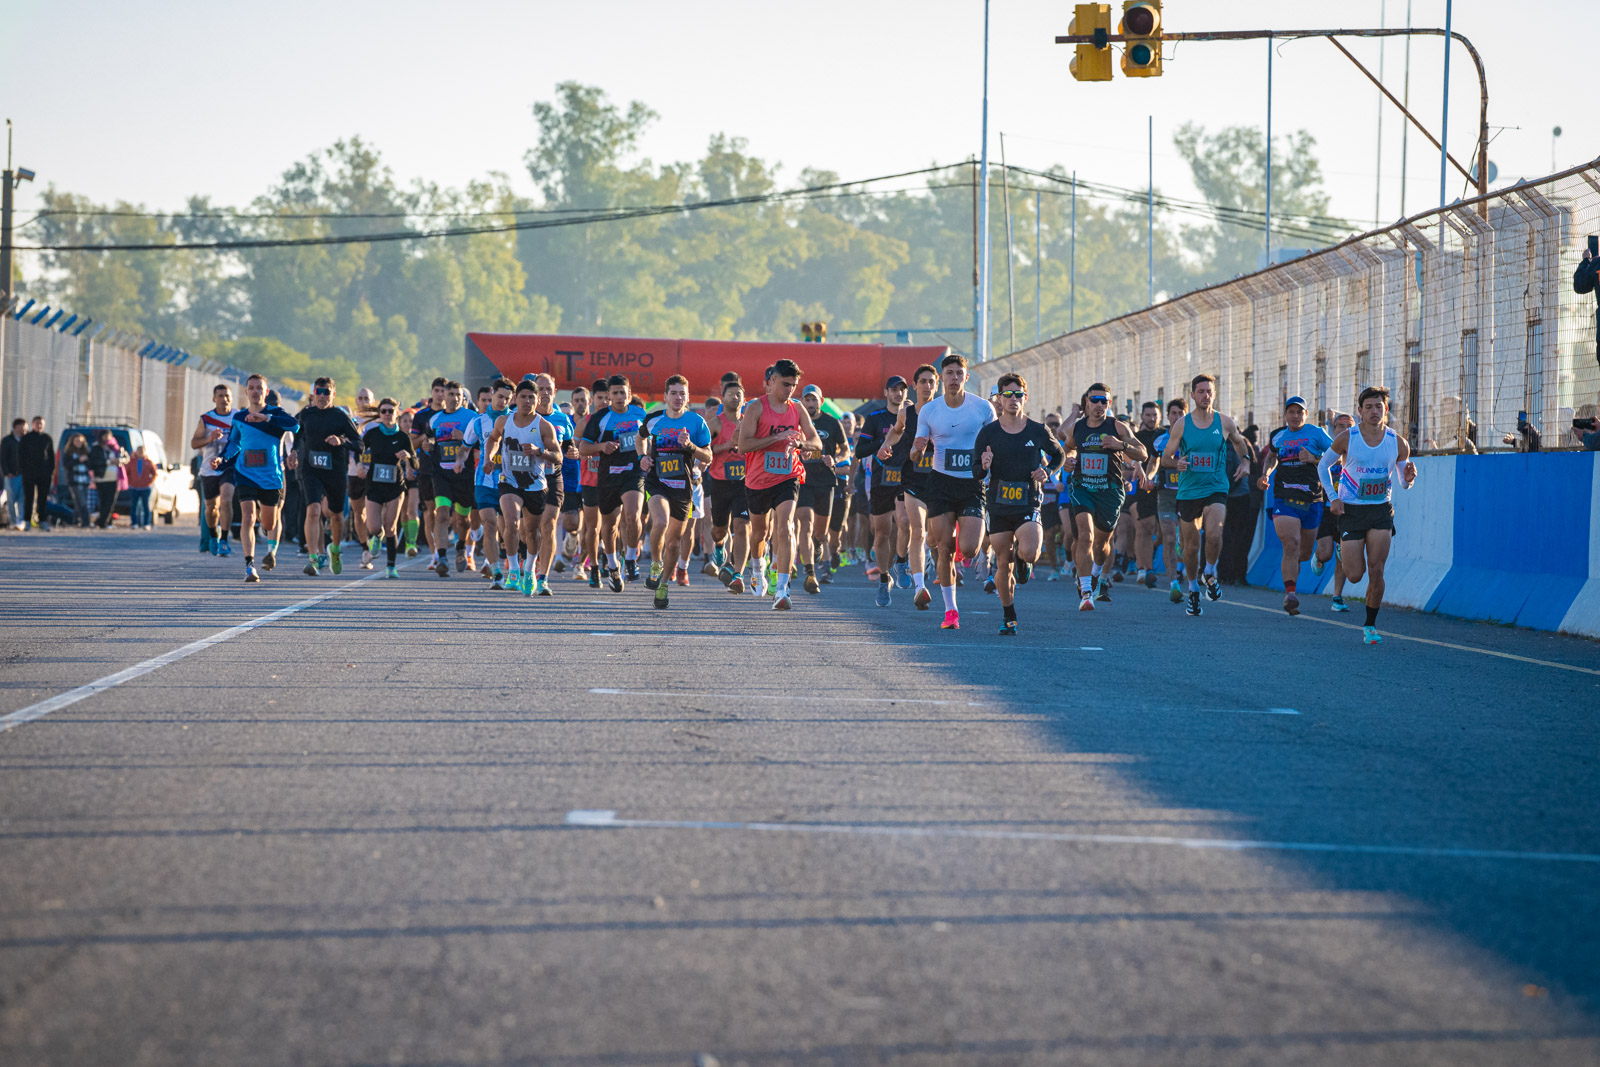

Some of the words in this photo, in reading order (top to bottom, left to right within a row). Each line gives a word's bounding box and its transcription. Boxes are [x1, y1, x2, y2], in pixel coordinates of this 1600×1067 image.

[313, 455, 328, 466] 167
[512, 455, 530, 467] 174
[660, 459, 679, 472] 707
[770, 456, 788, 469] 313
[951, 454, 971, 467] 106
[1085, 458, 1103, 470] 317
[1193, 456, 1211, 467] 344
[380, 468, 390, 479] 21
[729, 465, 745, 477] 712
[1002, 486, 1022, 500] 706
[1365, 482, 1385, 495] 303
